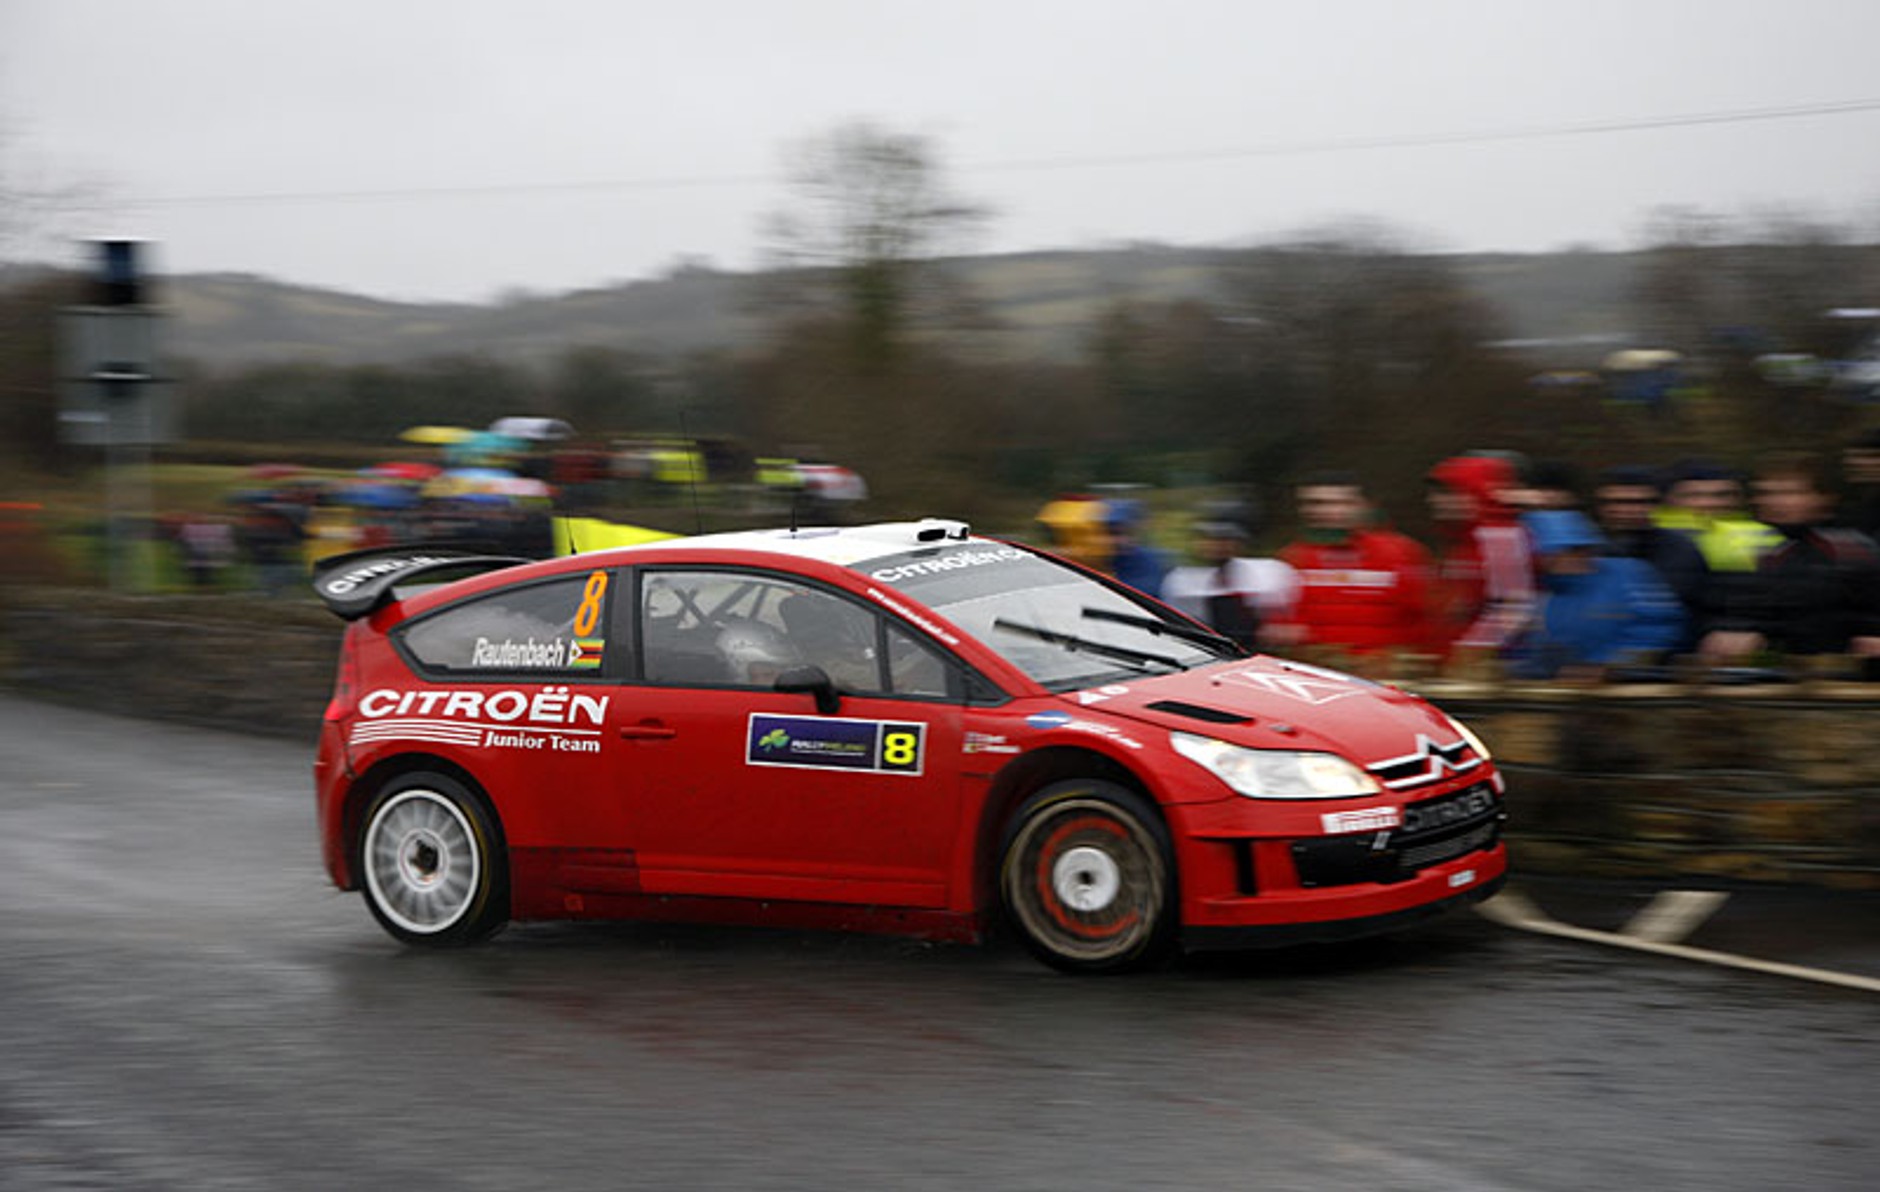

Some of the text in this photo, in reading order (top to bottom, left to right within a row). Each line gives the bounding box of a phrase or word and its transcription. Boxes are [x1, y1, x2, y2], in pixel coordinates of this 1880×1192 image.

[573, 570, 608, 637] 8
[471, 636, 565, 668] Rautenbach
[357, 685, 610, 726] CITROËN
[484, 731, 601, 753] Junior Team
[883, 732, 916, 765] 8
